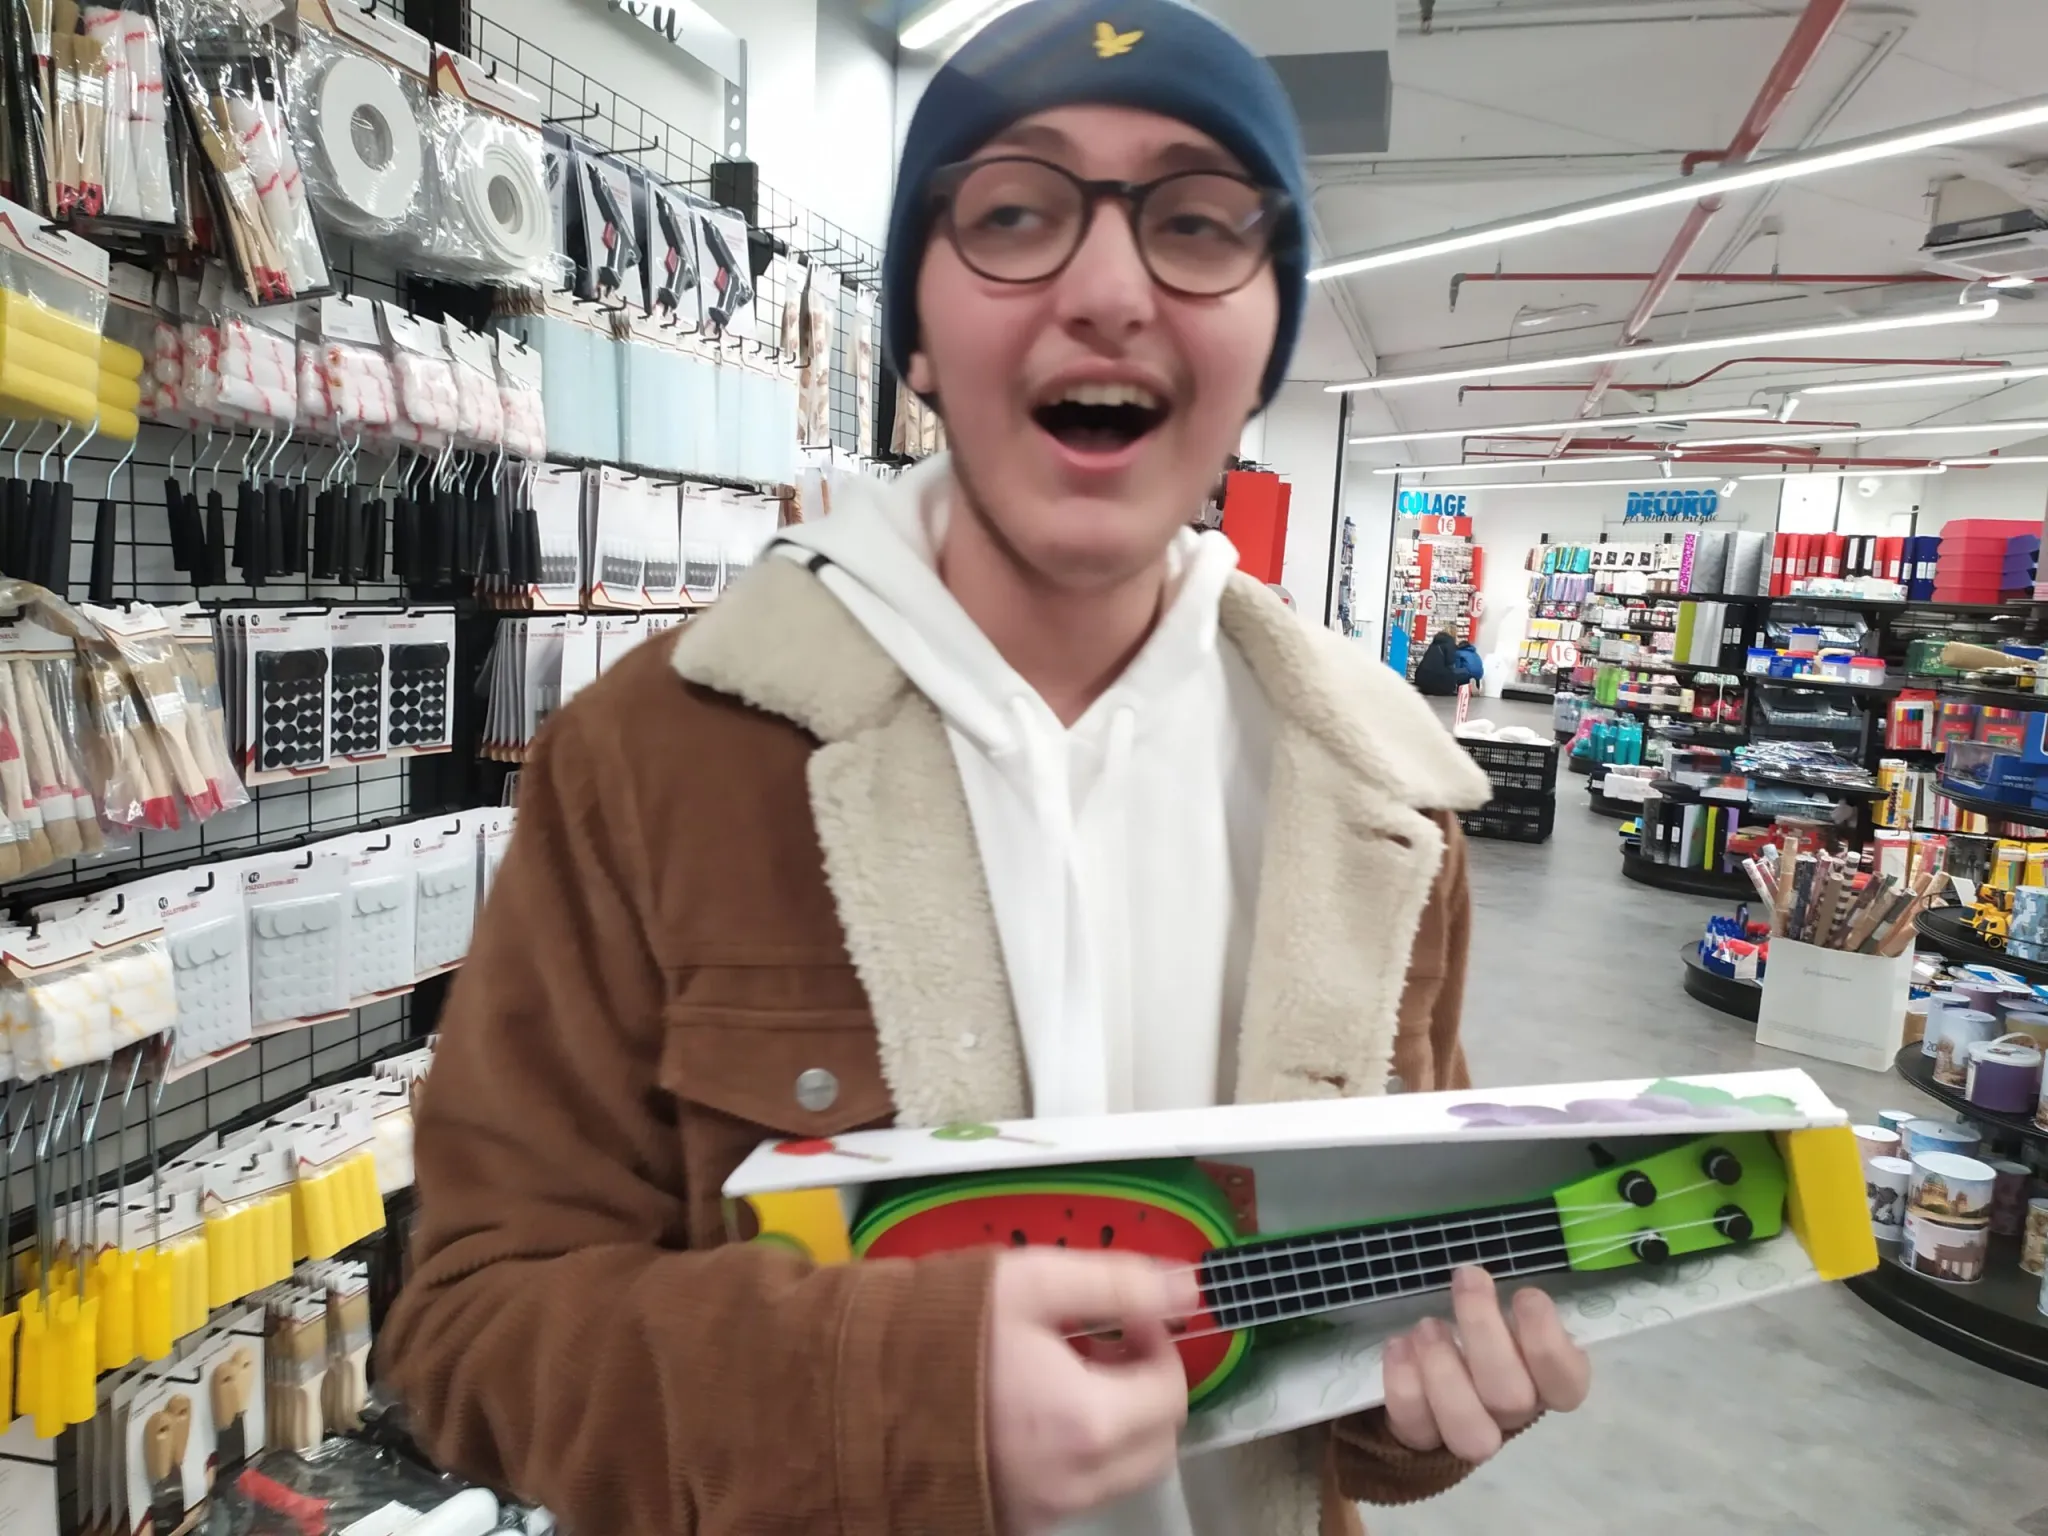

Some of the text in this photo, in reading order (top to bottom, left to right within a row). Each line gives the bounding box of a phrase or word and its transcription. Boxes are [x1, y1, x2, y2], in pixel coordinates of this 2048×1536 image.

[1626, 489, 1718, 517] DECORO
[1441, 518, 1454, 532] 1€
[1419, 595, 1433, 610] 1€
[1471, 596, 1483, 612] 1€
[1556, 645, 1573, 661] 1€
